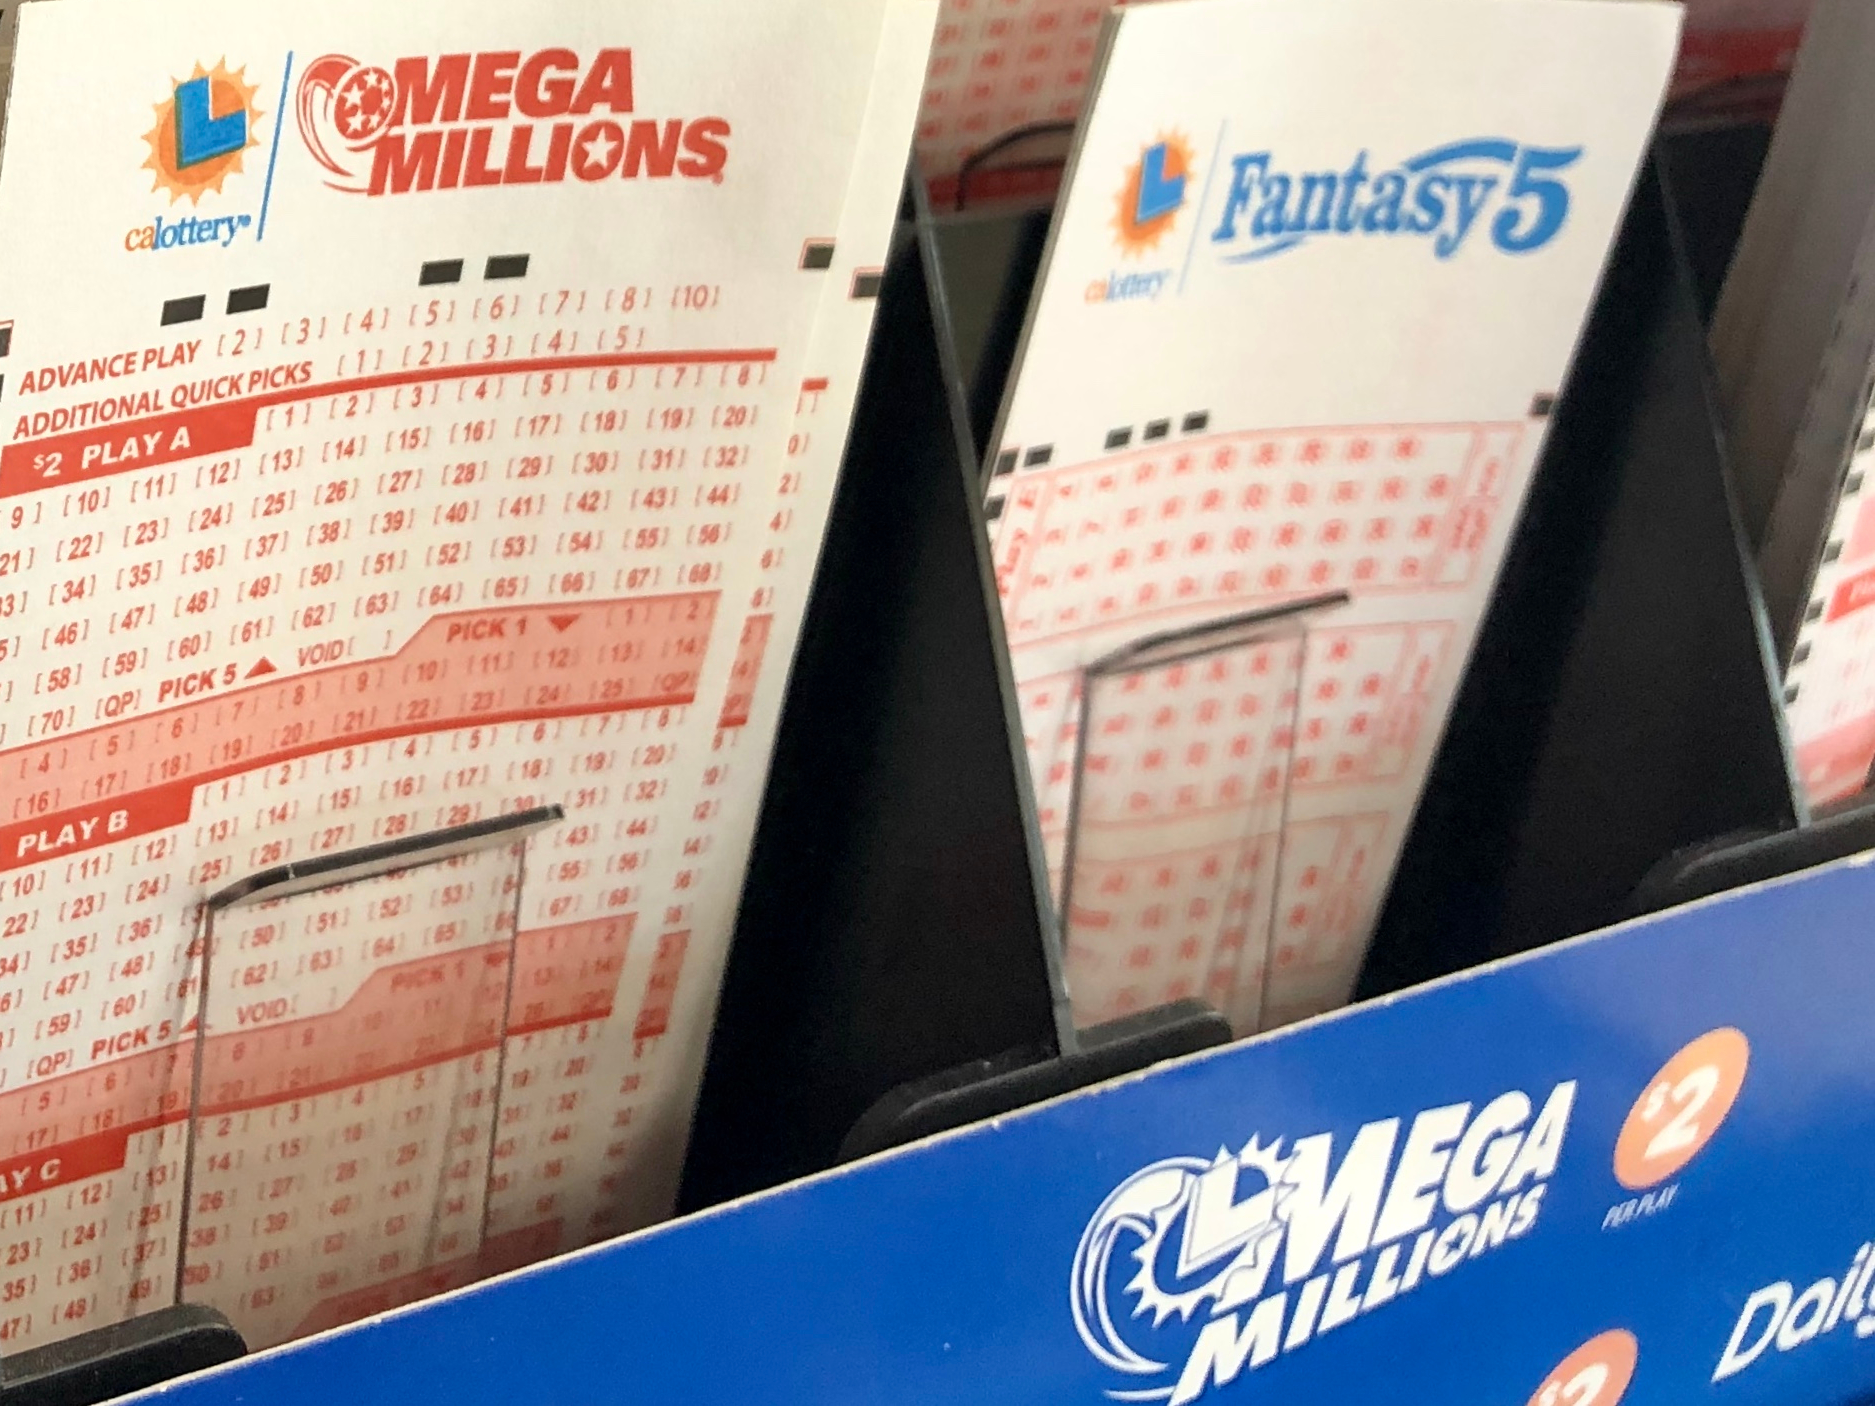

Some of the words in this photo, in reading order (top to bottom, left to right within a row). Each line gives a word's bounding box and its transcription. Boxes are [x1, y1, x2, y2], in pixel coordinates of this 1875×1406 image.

[388, 47, 634, 127] MEGA
[367, 116, 731, 197] MILLIONS
[125, 215, 249, 252] calottery
[19, 352, 136, 395] ADVANCE
[141, 340, 201, 371] PLAY
[13, 389, 164, 440] ADDITIONAL
[170, 372, 243, 408] QUICK
[248, 361, 313, 393] PICKS
[33, 452, 63, 478] $2
[81, 431, 162, 470] PLAY
[170, 426, 191, 451] A
[298, 639, 345, 667] VOID
[446, 619, 505, 643] PICK
[157, 668, 217, 703] PICK
[223, 663, 237, 686] 5
[17, 816, 100, 858] PLAY
[107, 809, 129, 834] B
[236, 997, 286, 1026] VOID
[91, 1028, 150, 1060] PICK
[156, 1020, 172, 1042] 5
[1641, 1063, 1720, 1161] $2
[1211, 1080, 1577, 1314] MEGA
[1168, 1183, 1547, 1406] MILLIONS
